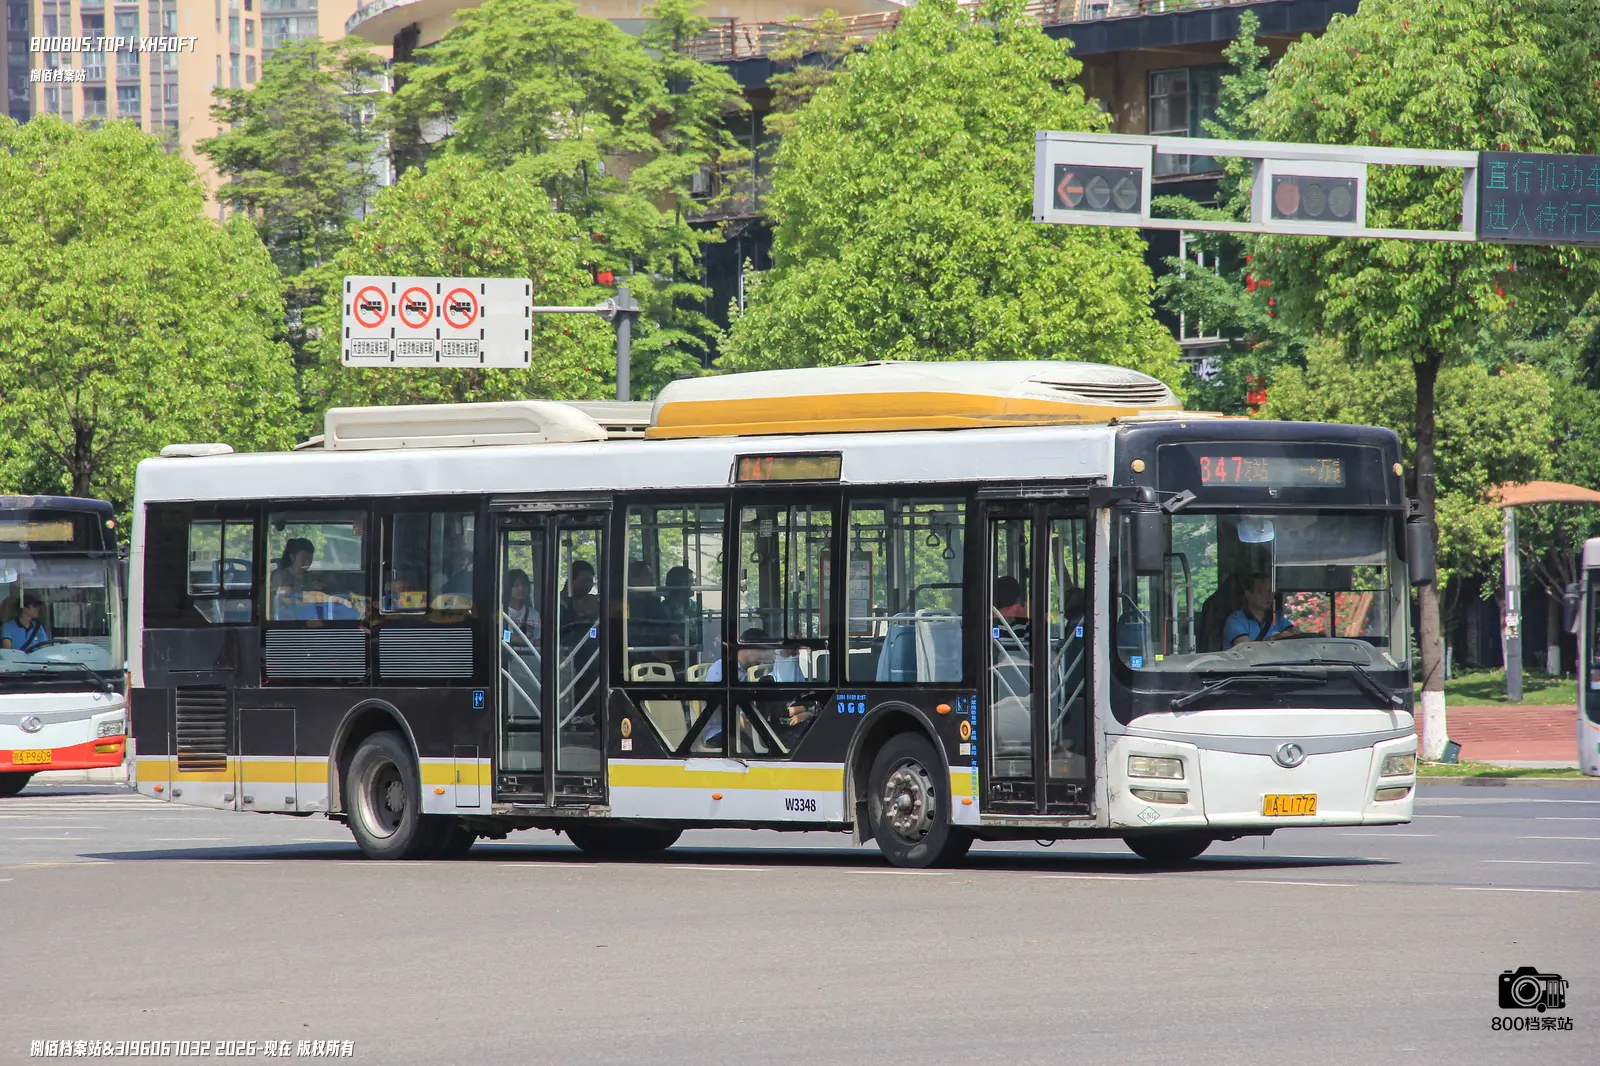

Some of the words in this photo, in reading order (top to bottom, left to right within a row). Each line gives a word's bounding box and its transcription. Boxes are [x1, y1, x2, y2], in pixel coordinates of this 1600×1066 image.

[1199, 456, 1243, 483] 347
[785, 797, 817, 813] W3348
[1141, 811, 1158, 820] CNG
